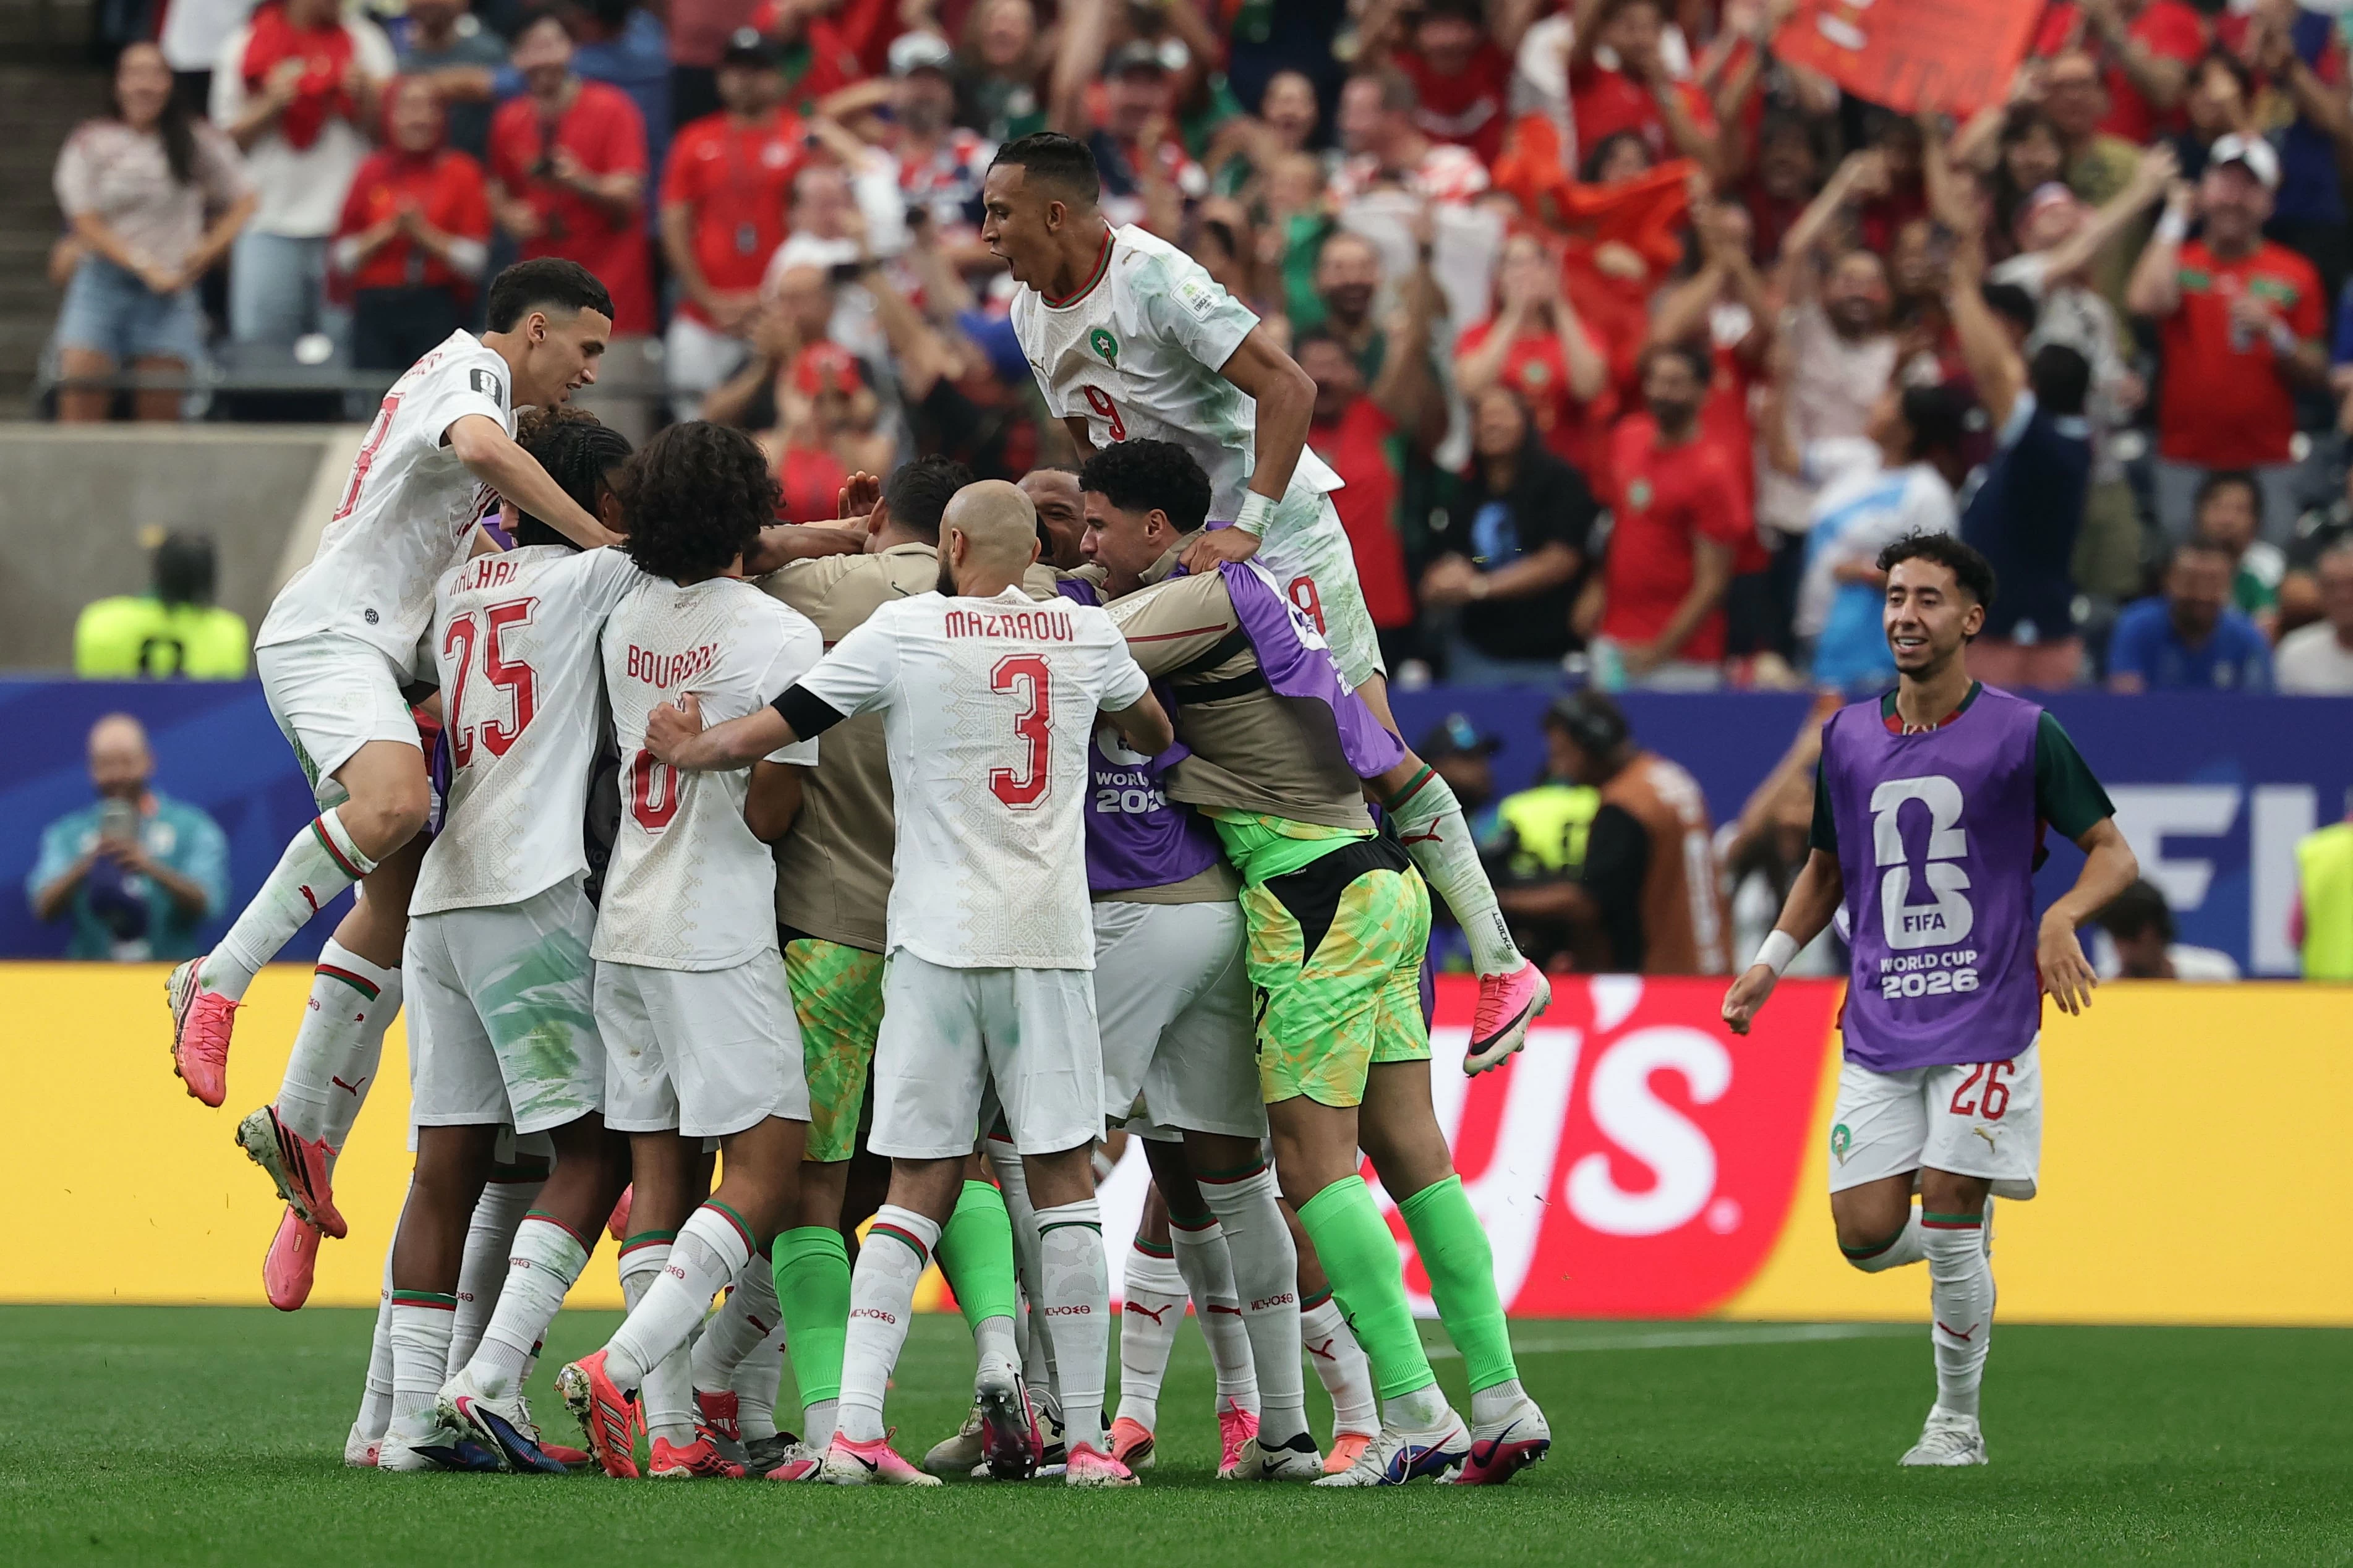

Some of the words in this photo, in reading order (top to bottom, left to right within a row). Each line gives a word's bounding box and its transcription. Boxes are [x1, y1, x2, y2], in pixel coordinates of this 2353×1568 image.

[1083, 385, 1126, 441] 9
[945, 611, 1074, 642] MAZRAOUI
[1288, 575, 1326, 637] 9
[444, 597, 540, 774] 25
[989, 654, 1054, 811] 3
[1903, 912, 1946, 933] FIFA
[1879, 953, 1939, 979] WORLD
[1941, 949, 1978, 974] CUP
[1881, 967, 1980, 1000] 2026
[1949, 1059, 2015, 1121] 26
